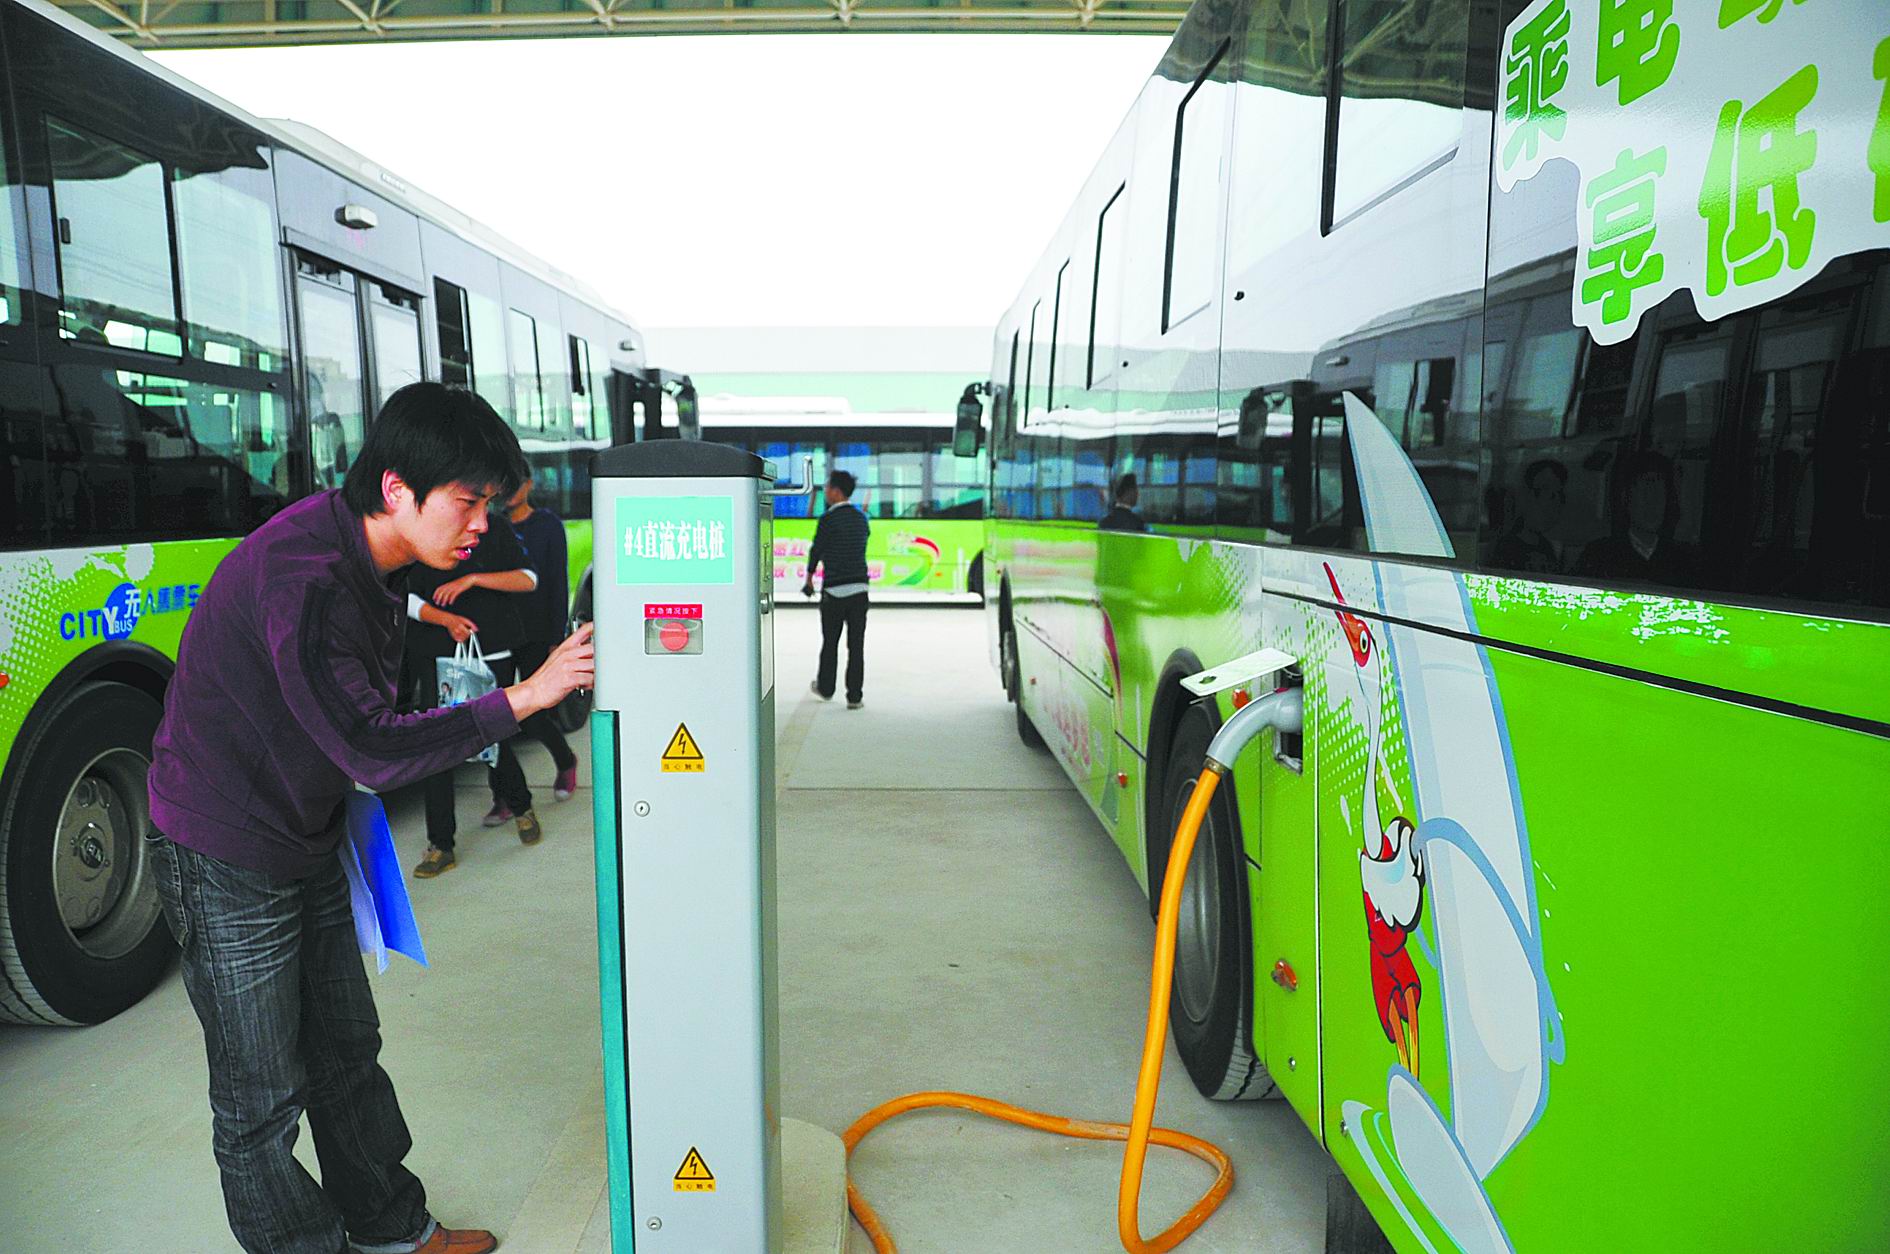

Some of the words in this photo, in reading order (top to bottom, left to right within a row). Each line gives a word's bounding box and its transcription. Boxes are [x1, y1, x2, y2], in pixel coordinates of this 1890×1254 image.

[1503, 0, 1808, 170] 乘电
[624, 519, 726, 561] #4直流充电桩
[60, 606, 118, 641] CITY
[114, 618, 133, 633] BUS
